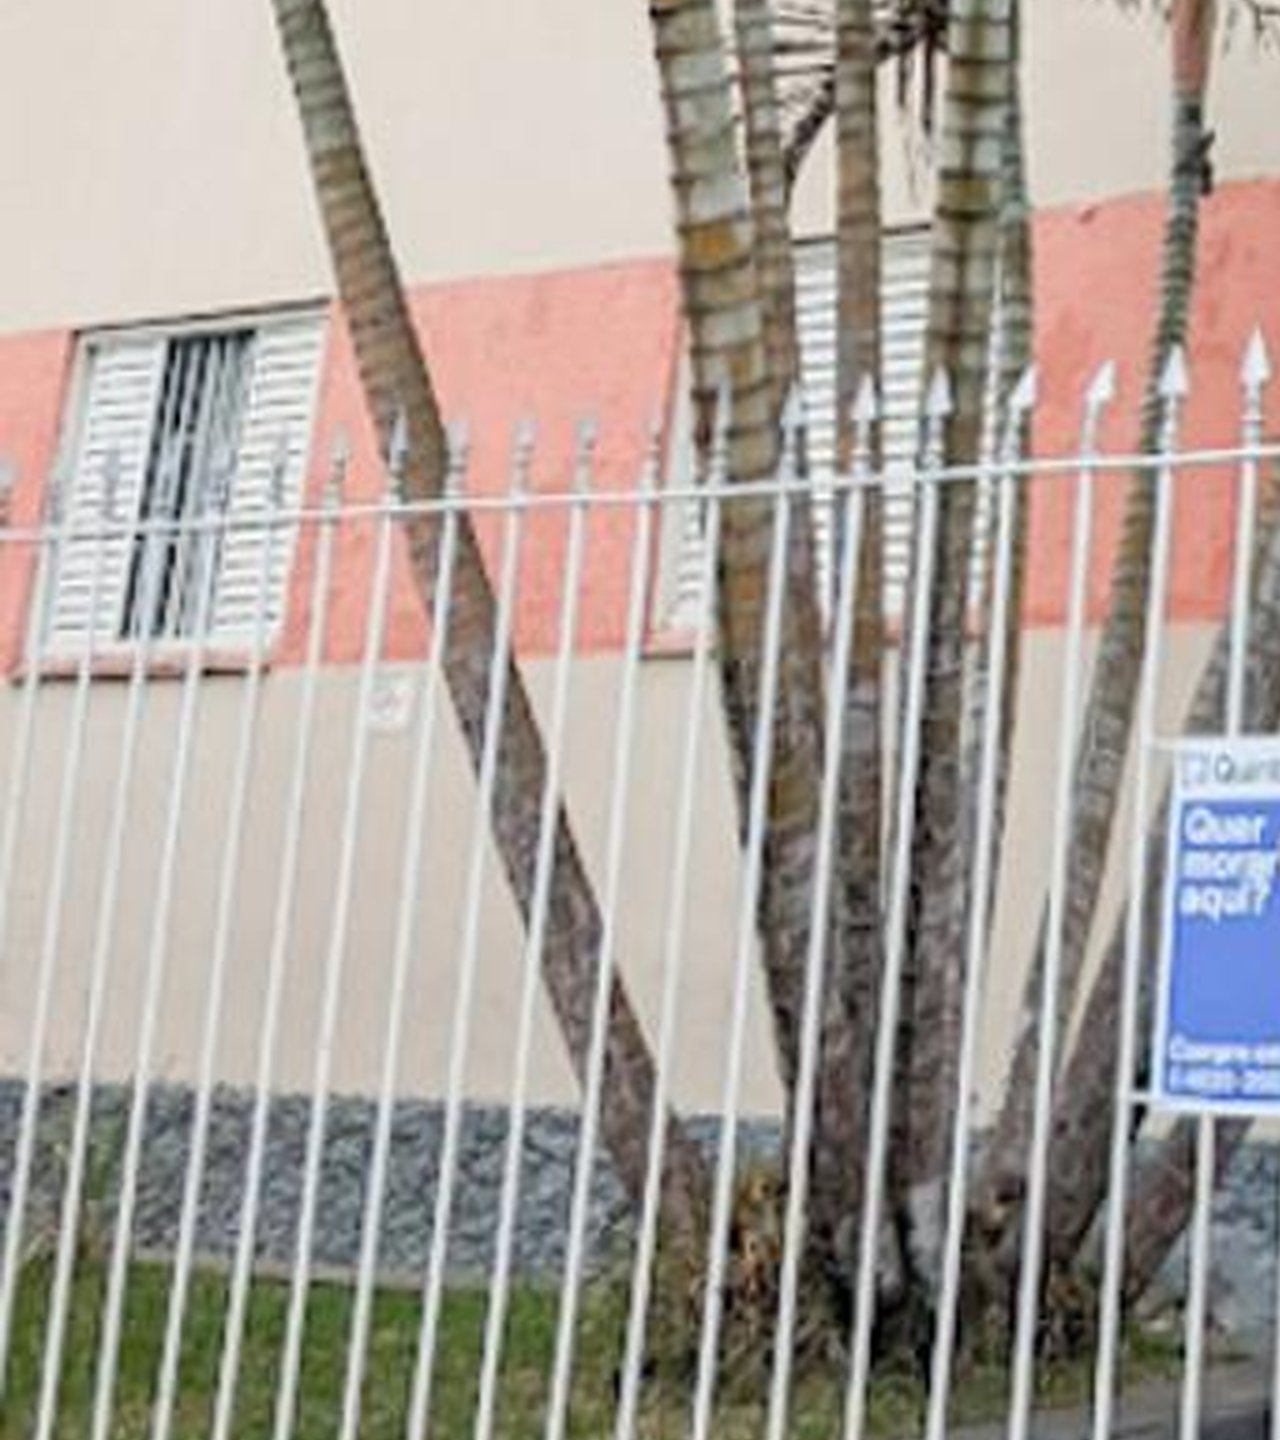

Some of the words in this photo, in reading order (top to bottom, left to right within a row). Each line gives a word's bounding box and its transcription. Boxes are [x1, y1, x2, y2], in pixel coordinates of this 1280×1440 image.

[1184, 807, 1266, 845] Quer
[1182, 851, 1276, 879] morar
[1180, 877, 1271, 923] aqui?
